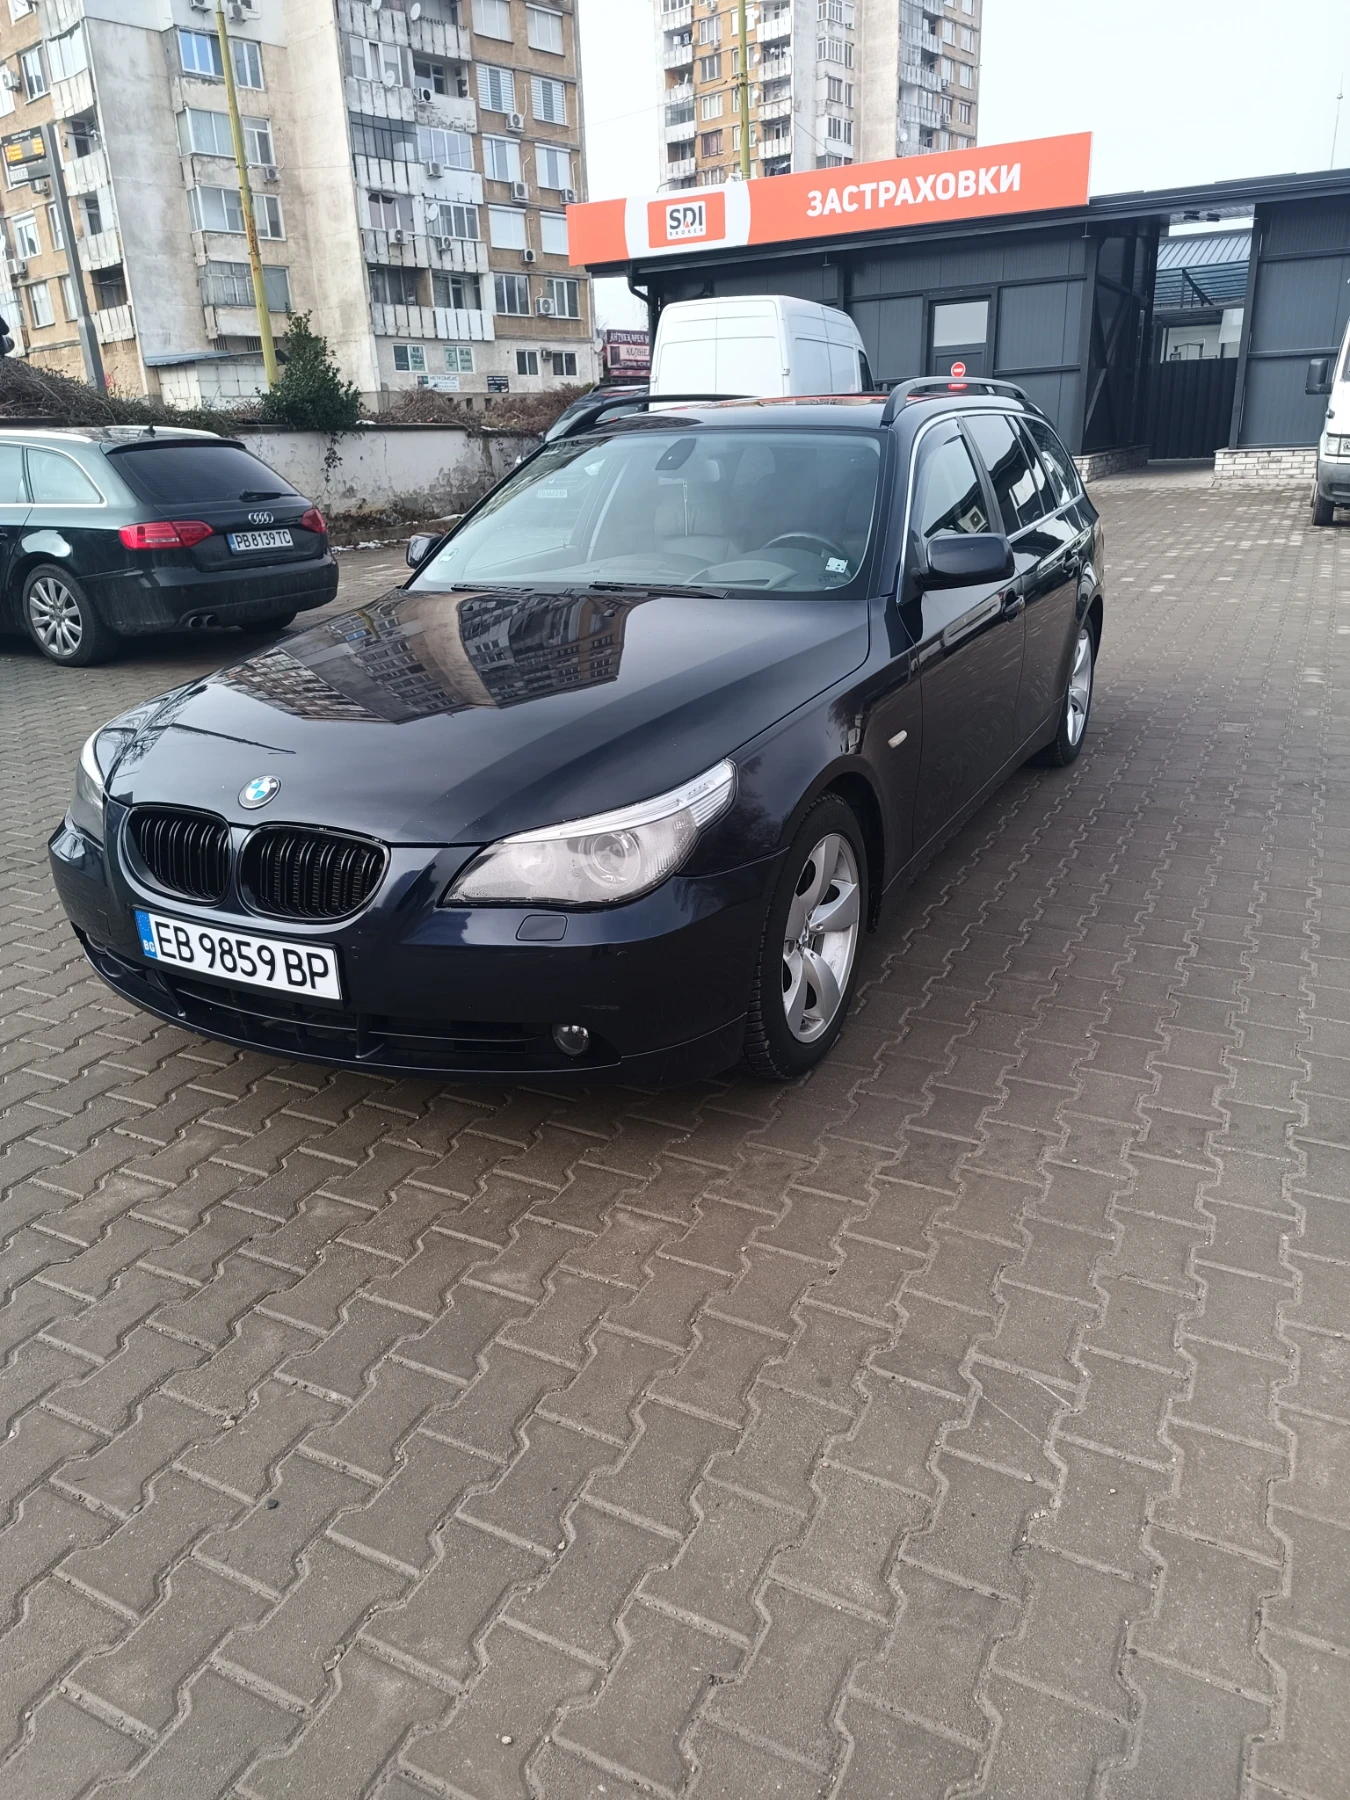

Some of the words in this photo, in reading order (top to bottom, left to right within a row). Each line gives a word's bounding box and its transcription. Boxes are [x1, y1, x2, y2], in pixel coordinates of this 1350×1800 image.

[806, 163, 1021, 217] ЗАСТРАХОВКИ
[669, 205, 703, 230] SDI
[669, 227, 703, 236] BROKER
[235, 533, 251, 548] PB
[251, 532, 276, 547] 8139
[276, 531, 291, 544] TC
[143, 939, 155, 953] BG
[154, 921, 195, 963] EB
[198, 932, 276, 982] 9859
[282, 947, 329, 989] BP
